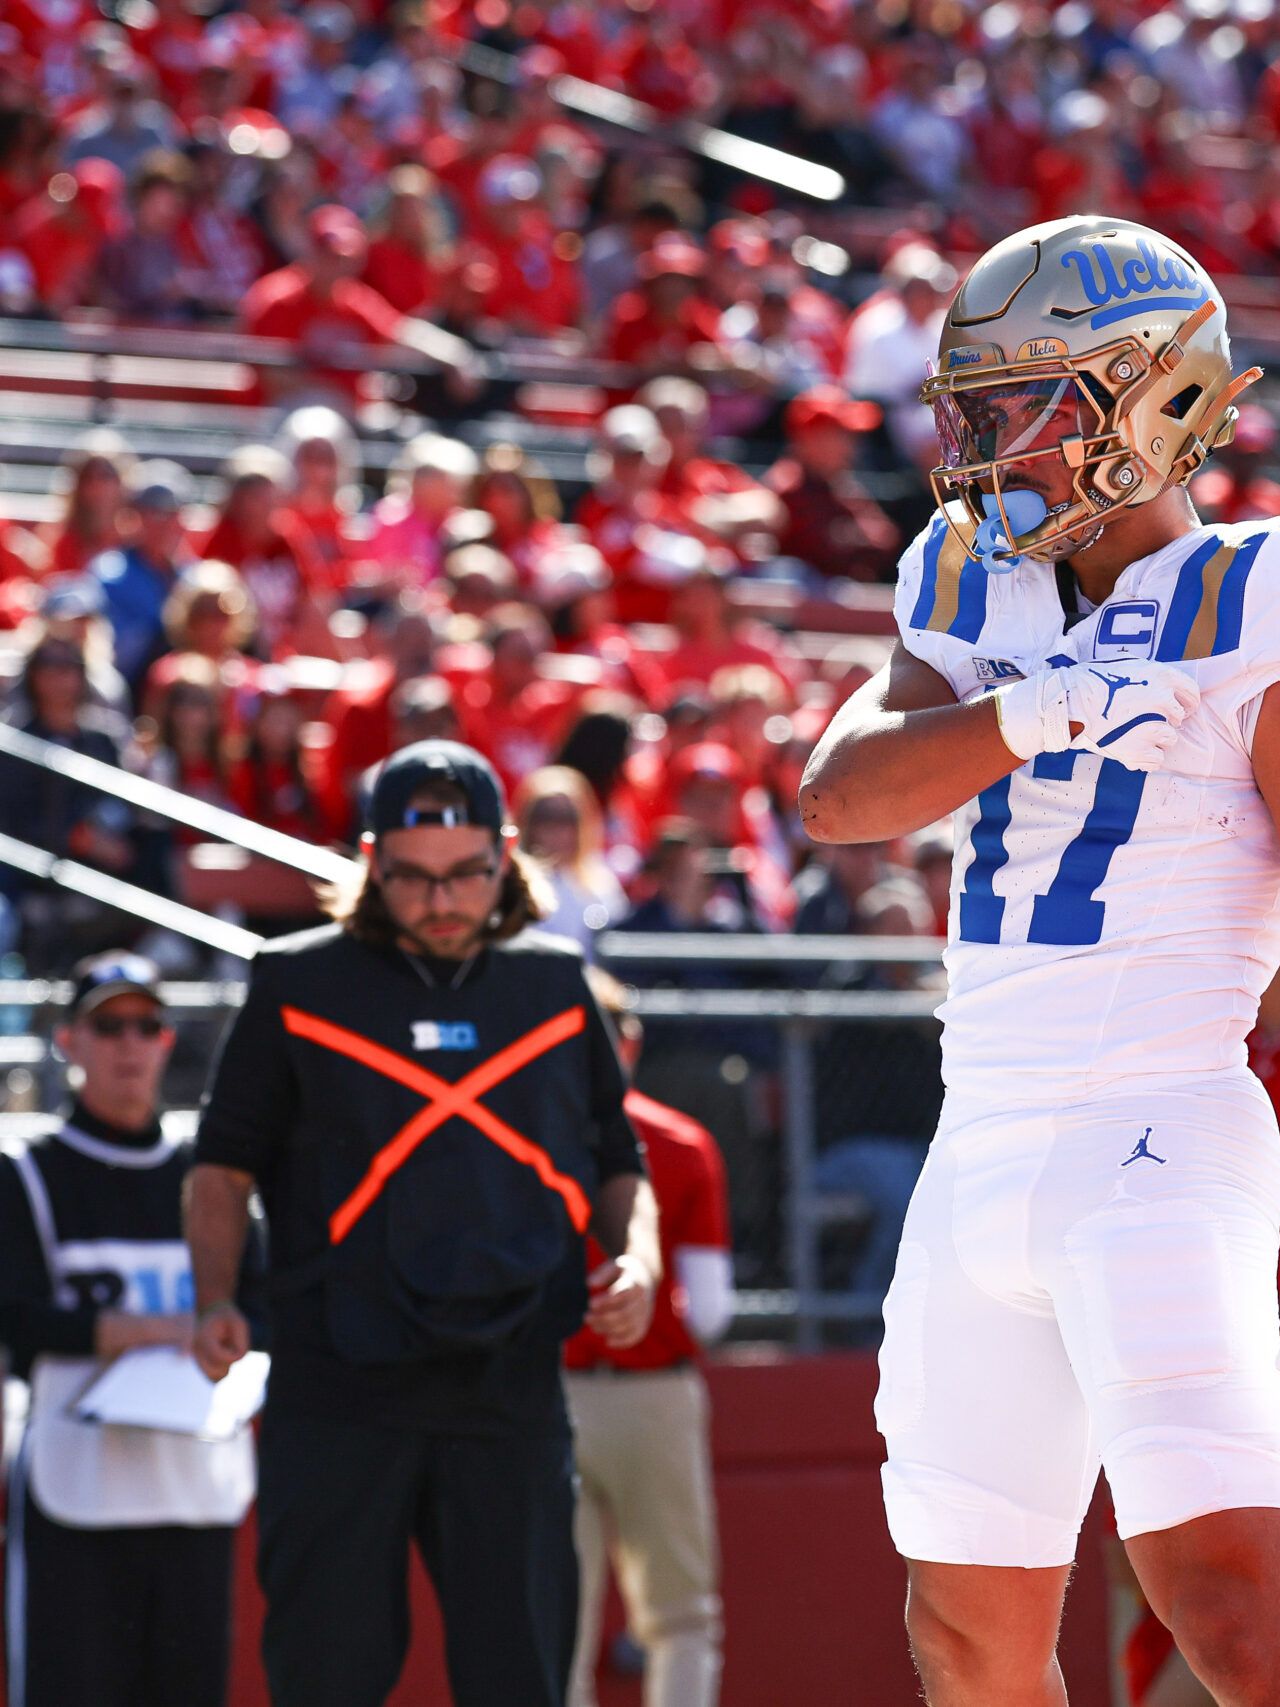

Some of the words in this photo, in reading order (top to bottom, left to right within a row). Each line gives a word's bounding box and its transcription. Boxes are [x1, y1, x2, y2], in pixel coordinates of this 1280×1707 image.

[1060, 238, 1209, 306] Ucla
[948, 349, 982, 368] Bruins
[1027, 340, 1057, 357] Ucla
[1098, 604, 1156, 645] C
[959, 748, 1148, 945] 17
